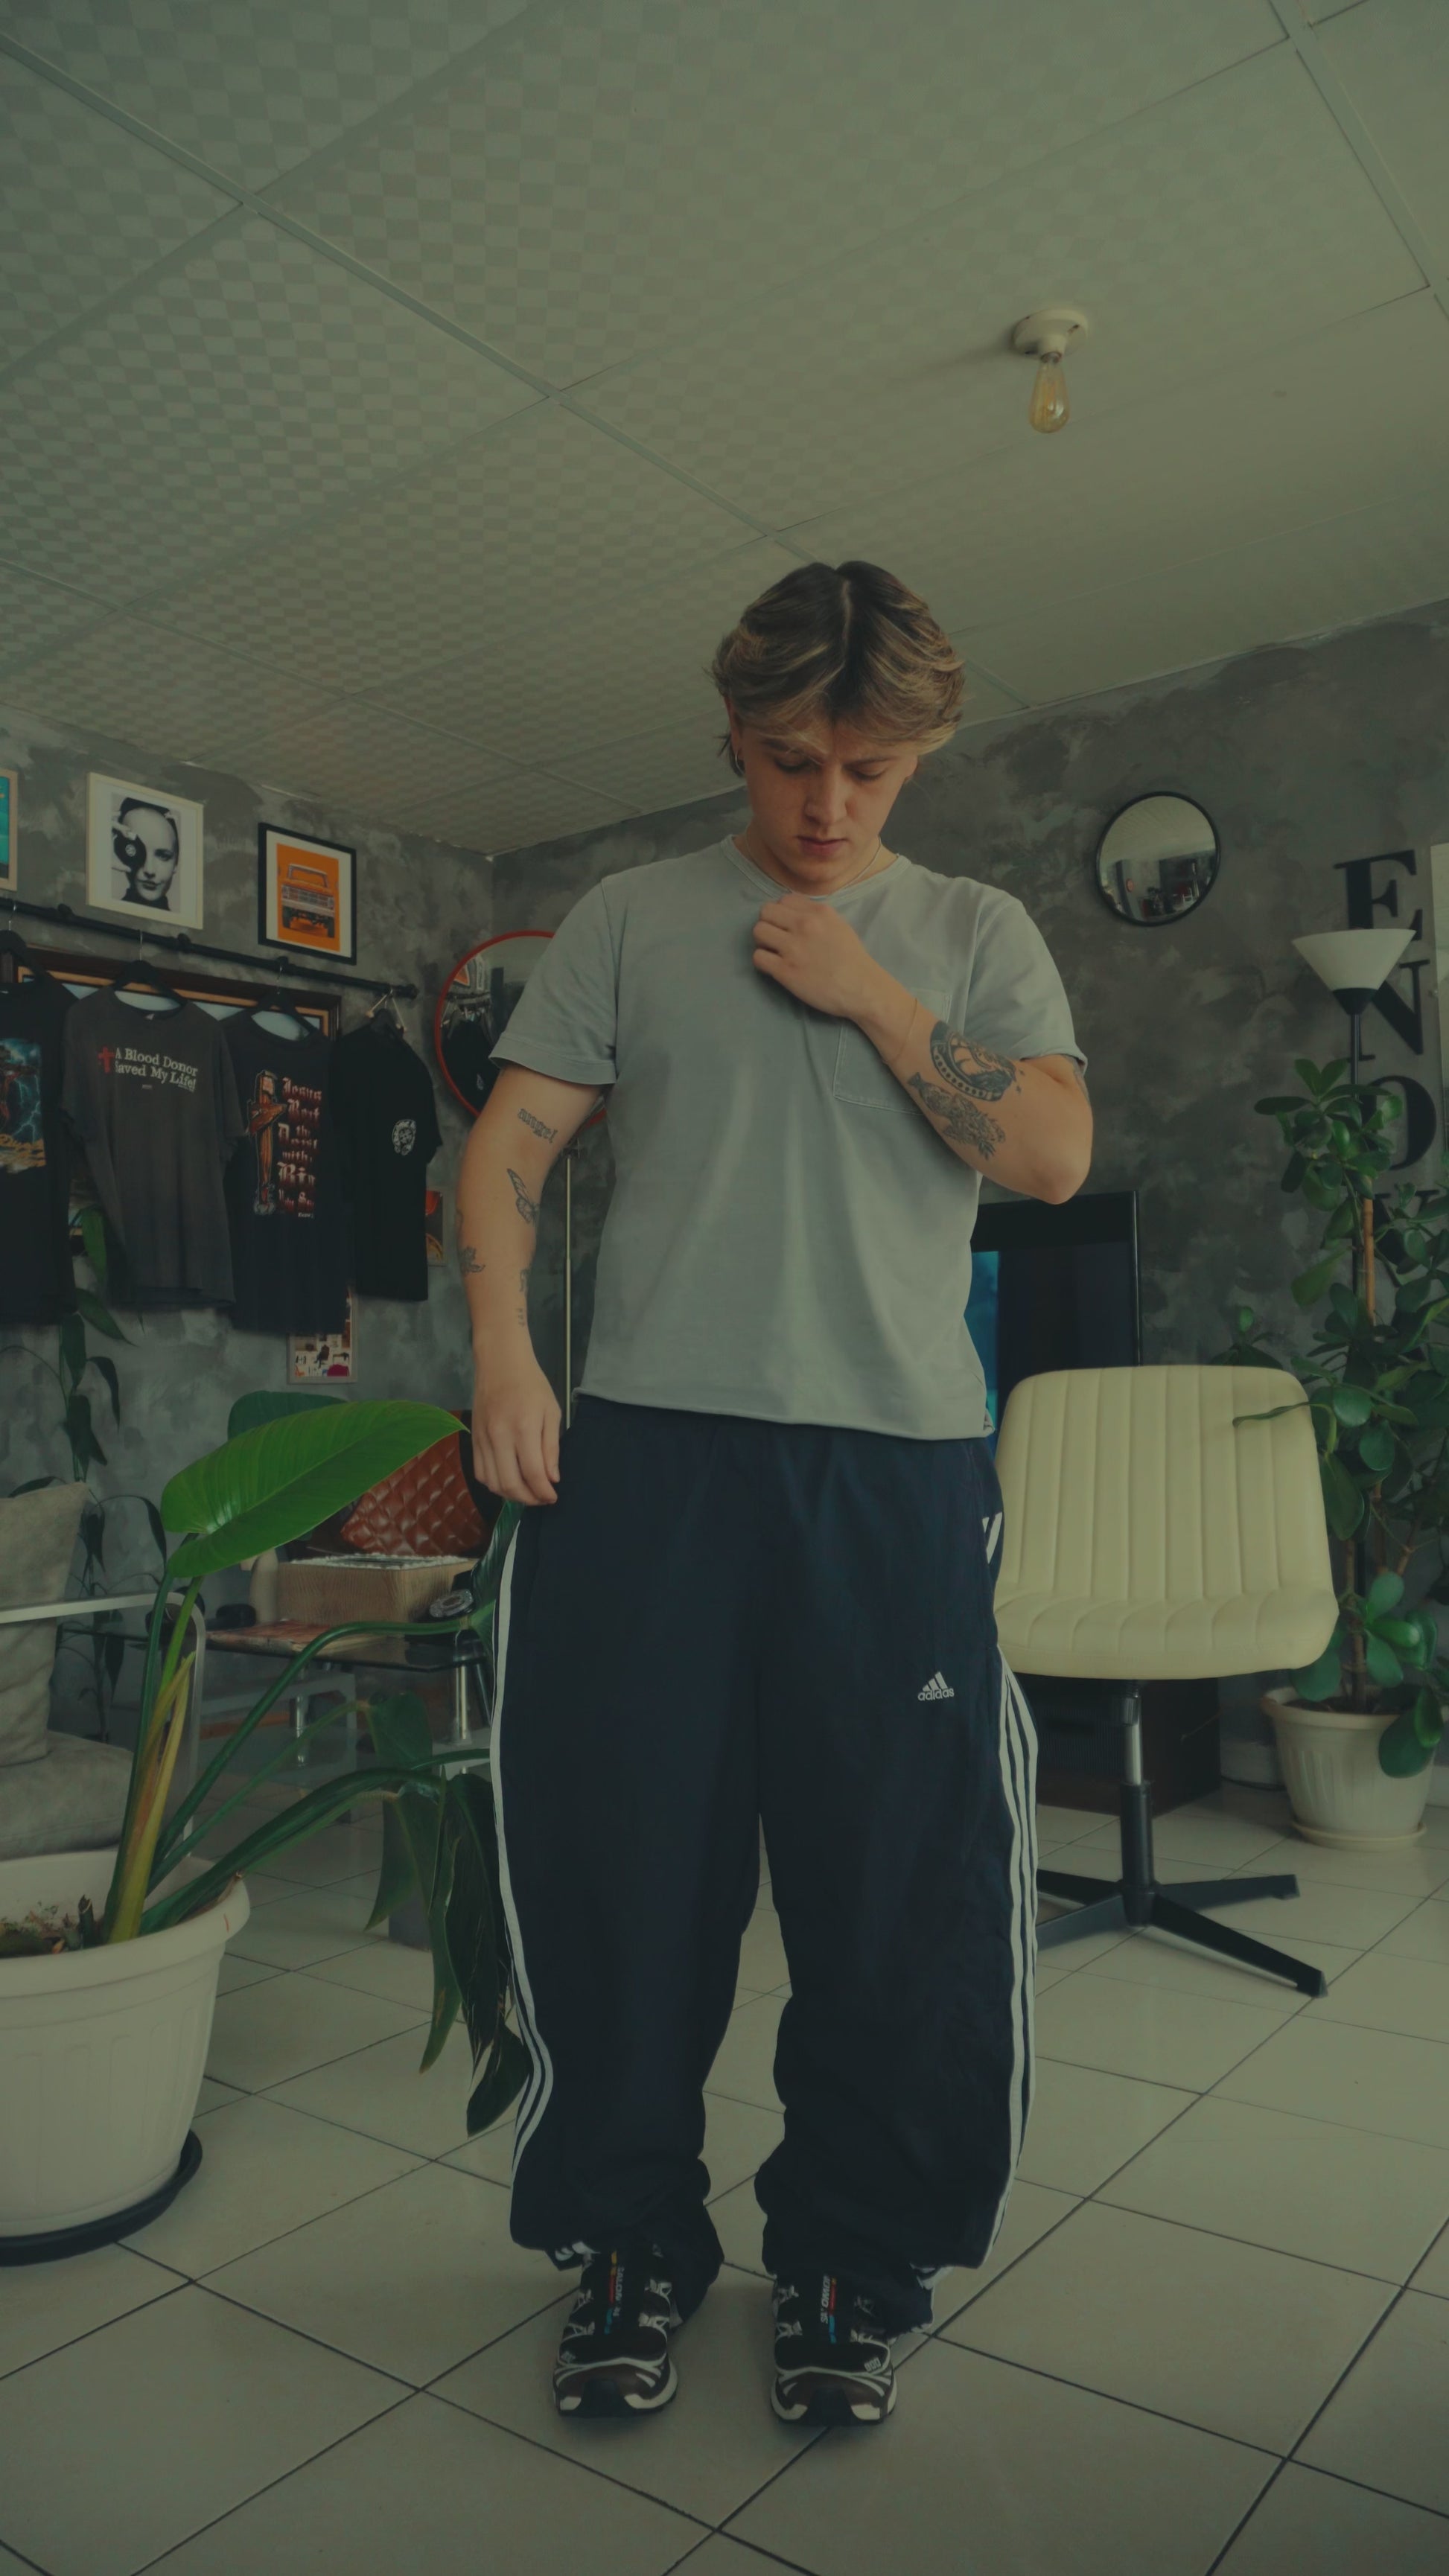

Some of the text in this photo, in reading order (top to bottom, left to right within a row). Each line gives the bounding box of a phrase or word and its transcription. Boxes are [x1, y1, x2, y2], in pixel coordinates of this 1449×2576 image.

[115, 1047, 199, 1077] A Blood Donor
[115, 1060, 147, 1077] Saved
[150, 1065, 168, 1085] My
[169, 1071, 197, 1091] Life!
[917, 1687, 955, 1702] adidas
